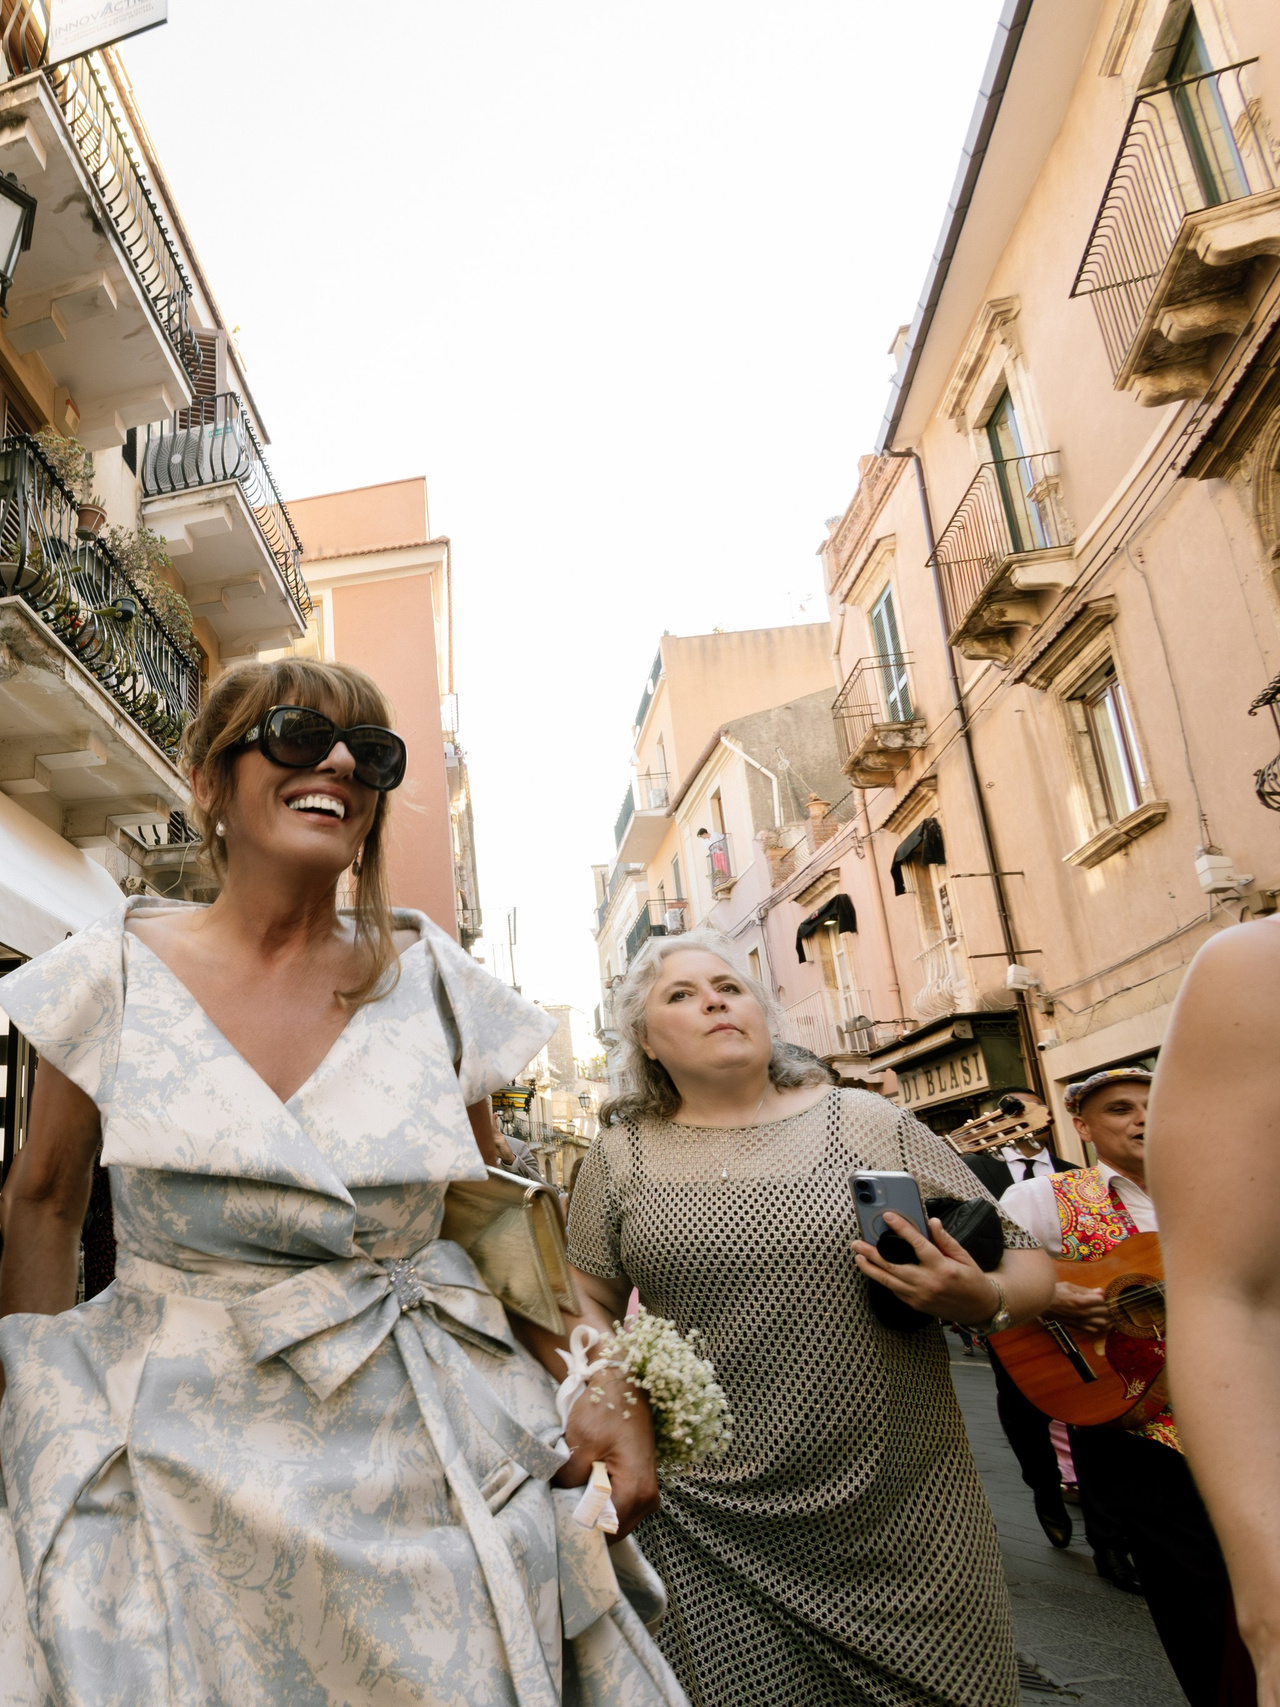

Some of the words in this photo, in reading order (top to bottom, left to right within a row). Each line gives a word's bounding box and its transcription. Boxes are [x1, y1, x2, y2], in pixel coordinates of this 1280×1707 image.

[54, 0, 146, 37] INNOVACT
[901, 1075, 921, 1104] DI
[923, 1052, 983, 1097] BLASI
